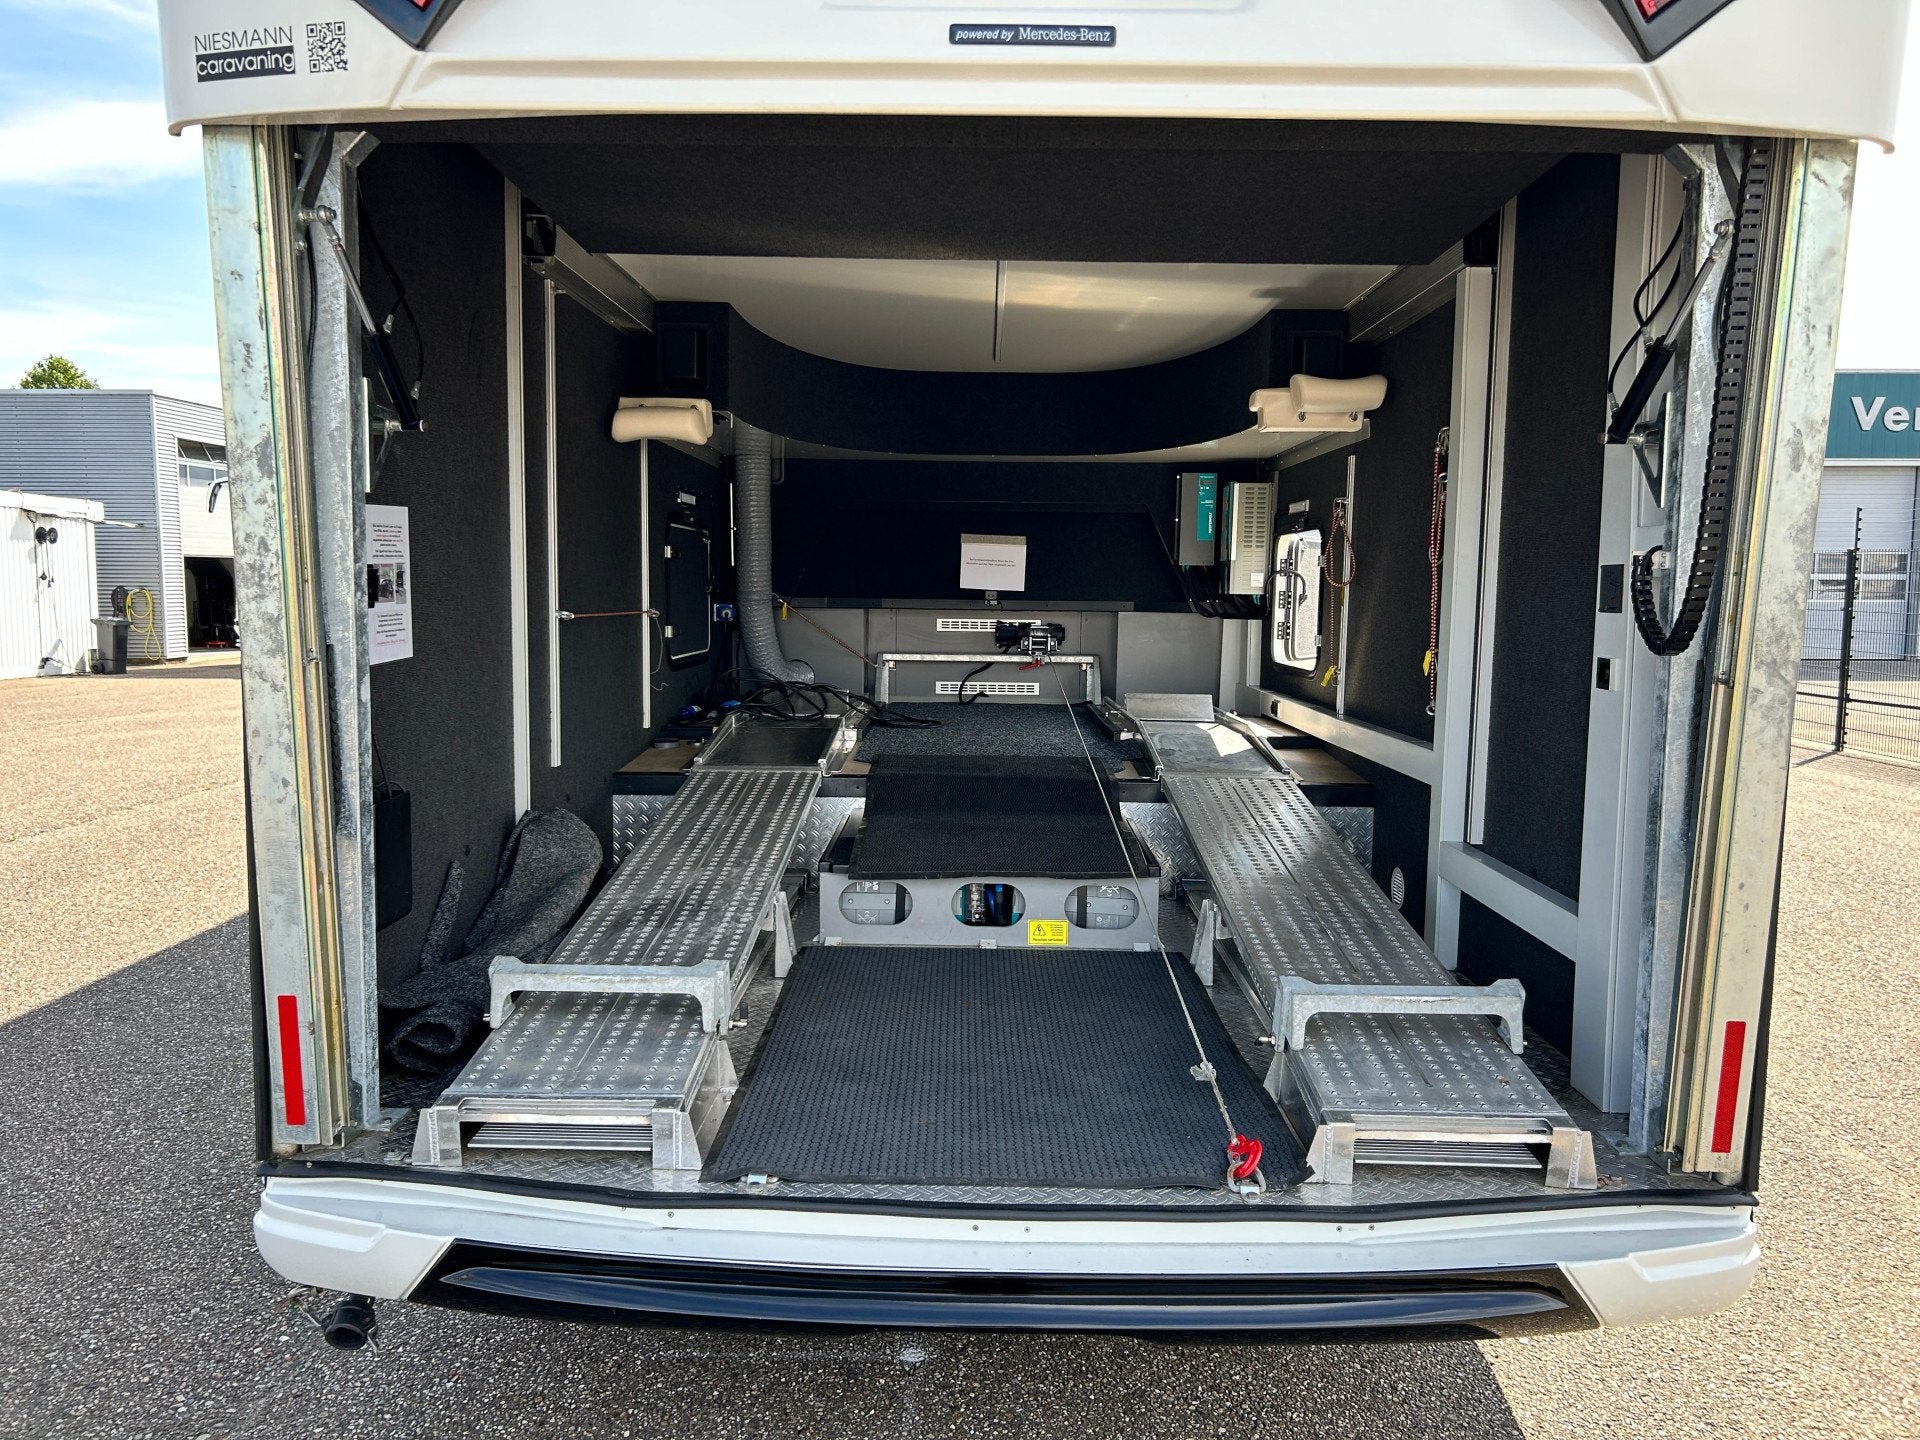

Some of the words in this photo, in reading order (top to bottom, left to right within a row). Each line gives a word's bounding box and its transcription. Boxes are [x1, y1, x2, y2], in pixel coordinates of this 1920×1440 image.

[194, 26, 293, 52] NIESMANN
[956, 29, 999, 41] powered
[1001, 29, 1014, 42] by
[1019, 27, 1110, 42] Mercedes-Benz
[196, 50, 295, 75] caravaning
